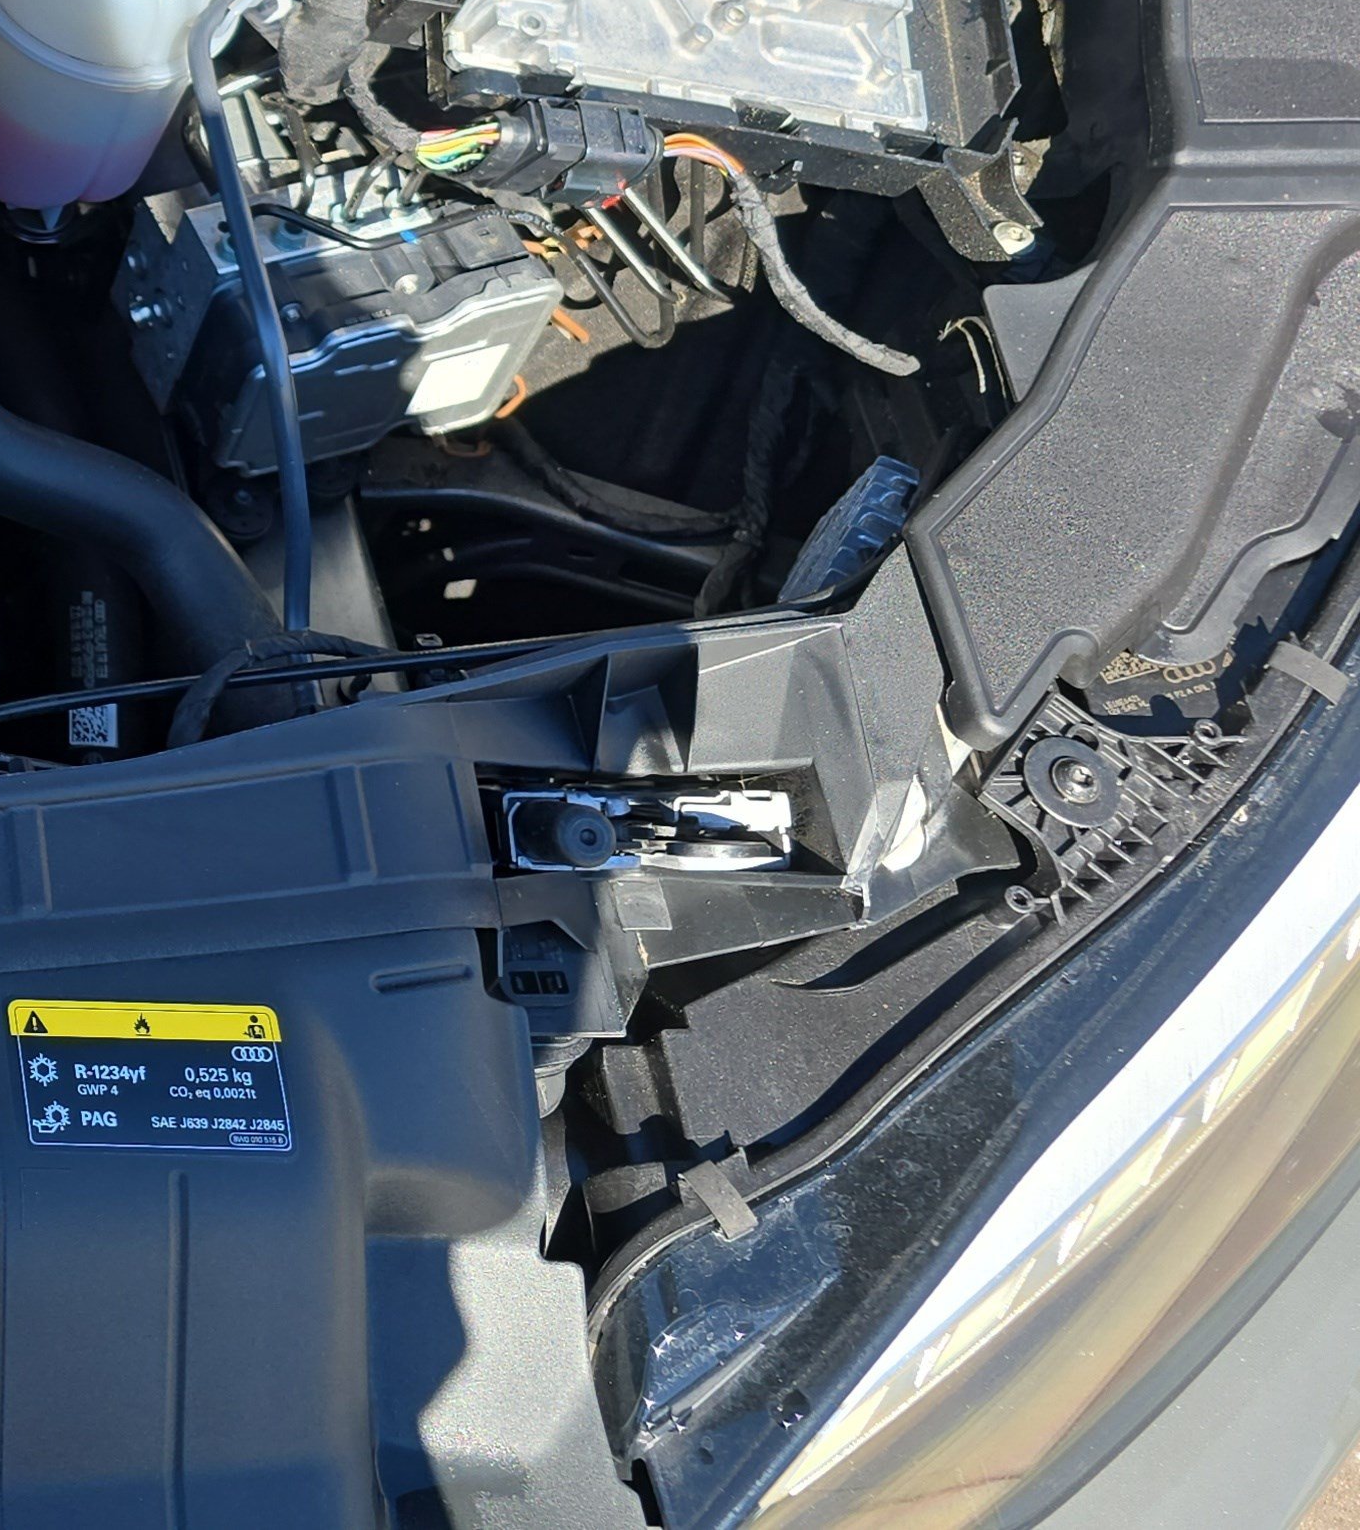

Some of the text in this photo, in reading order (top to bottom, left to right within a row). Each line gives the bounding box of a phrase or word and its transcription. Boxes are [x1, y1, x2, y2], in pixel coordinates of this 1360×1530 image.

[74, 1063, 253, 1086] R-1234yf 0,525 kg
[77, 1083, 119, 1096] GWP 4
[195, 1088, 211, 1101] eq
[80, 1110, 118, 1127] PAG
[150, 1116, 285, 1131] SAE J639 J2842 J2845
